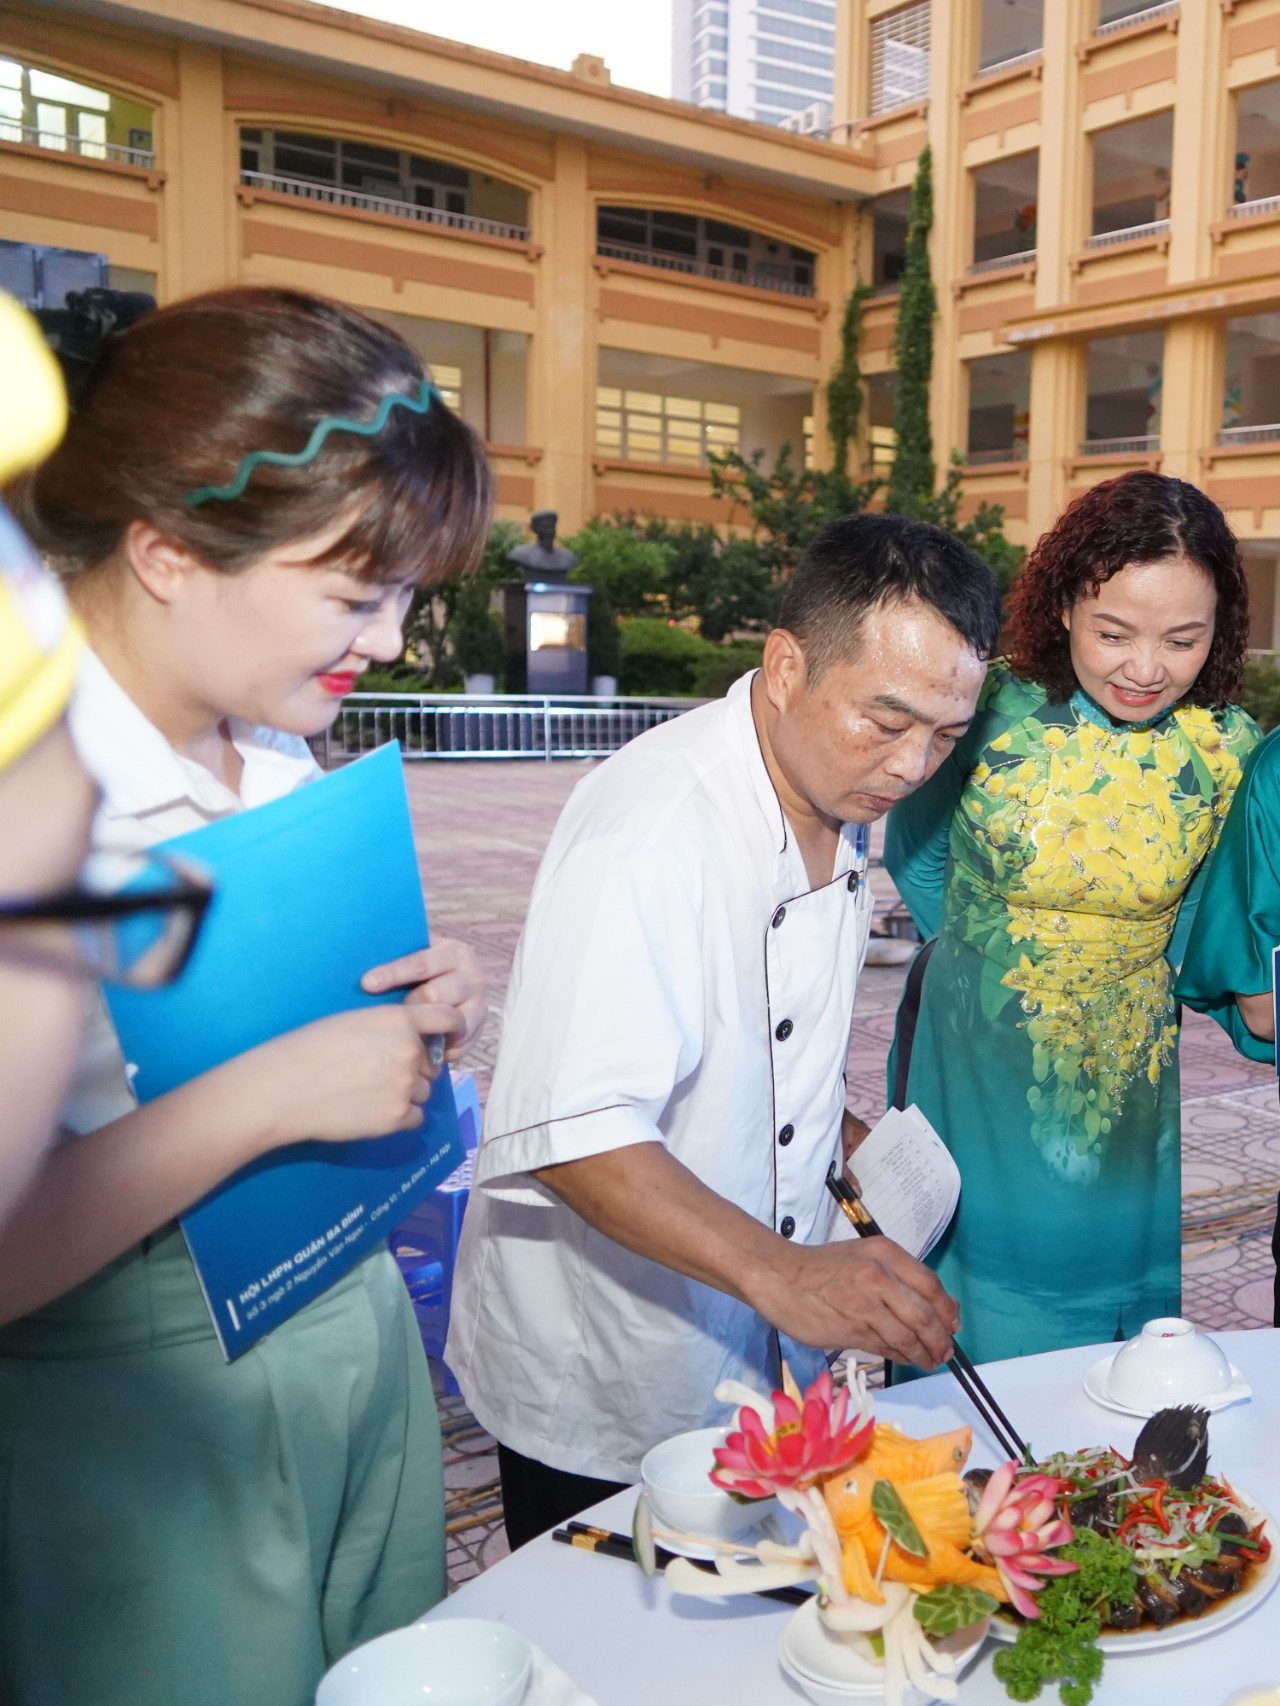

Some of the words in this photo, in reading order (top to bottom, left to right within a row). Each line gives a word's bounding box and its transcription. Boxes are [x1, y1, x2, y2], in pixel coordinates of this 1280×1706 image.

[239, 1282, 260, 1304] HỘI
[261, 1260, 293, 1287] LHPN
[294, 1236, 326, 1264] QUẬN
[326, 1225, 341, 1241] BA
[341, 1204, 364, 1228] ĐÌNH
[260, 1300, 267, 1310] 3
